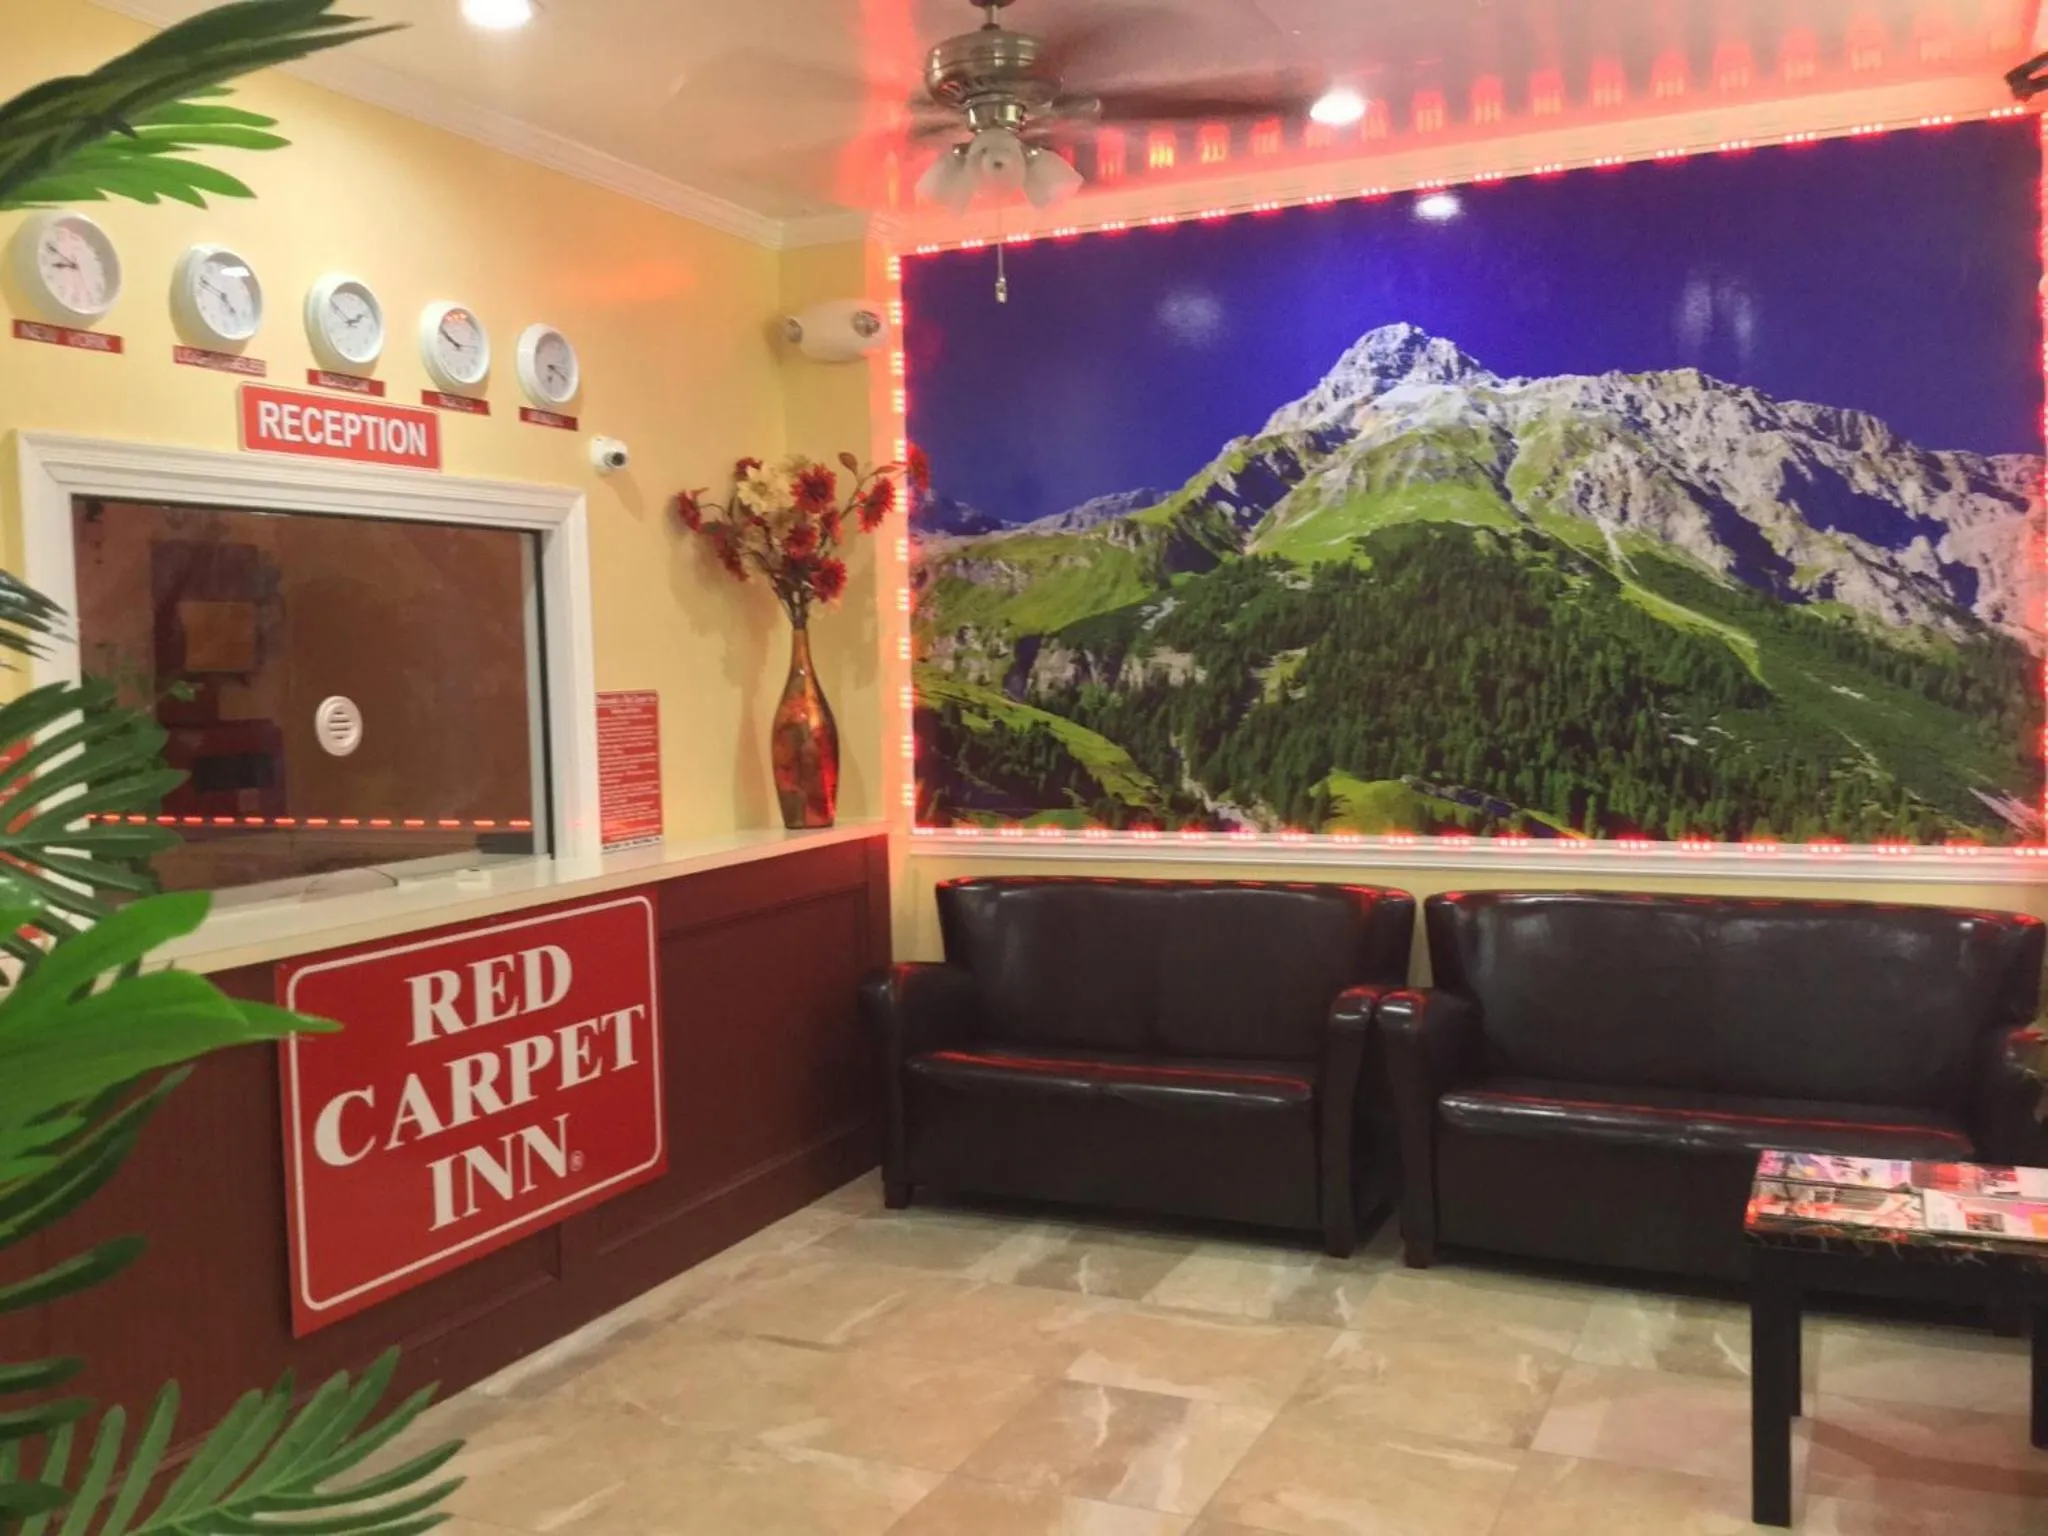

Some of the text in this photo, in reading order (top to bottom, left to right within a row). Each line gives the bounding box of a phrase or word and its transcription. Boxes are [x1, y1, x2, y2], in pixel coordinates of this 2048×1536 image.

[257, 400, 429, 458] RECEPTION
[404, 944, 573, 1046] RED
[314, 1005, 645, 1166] CARPET
